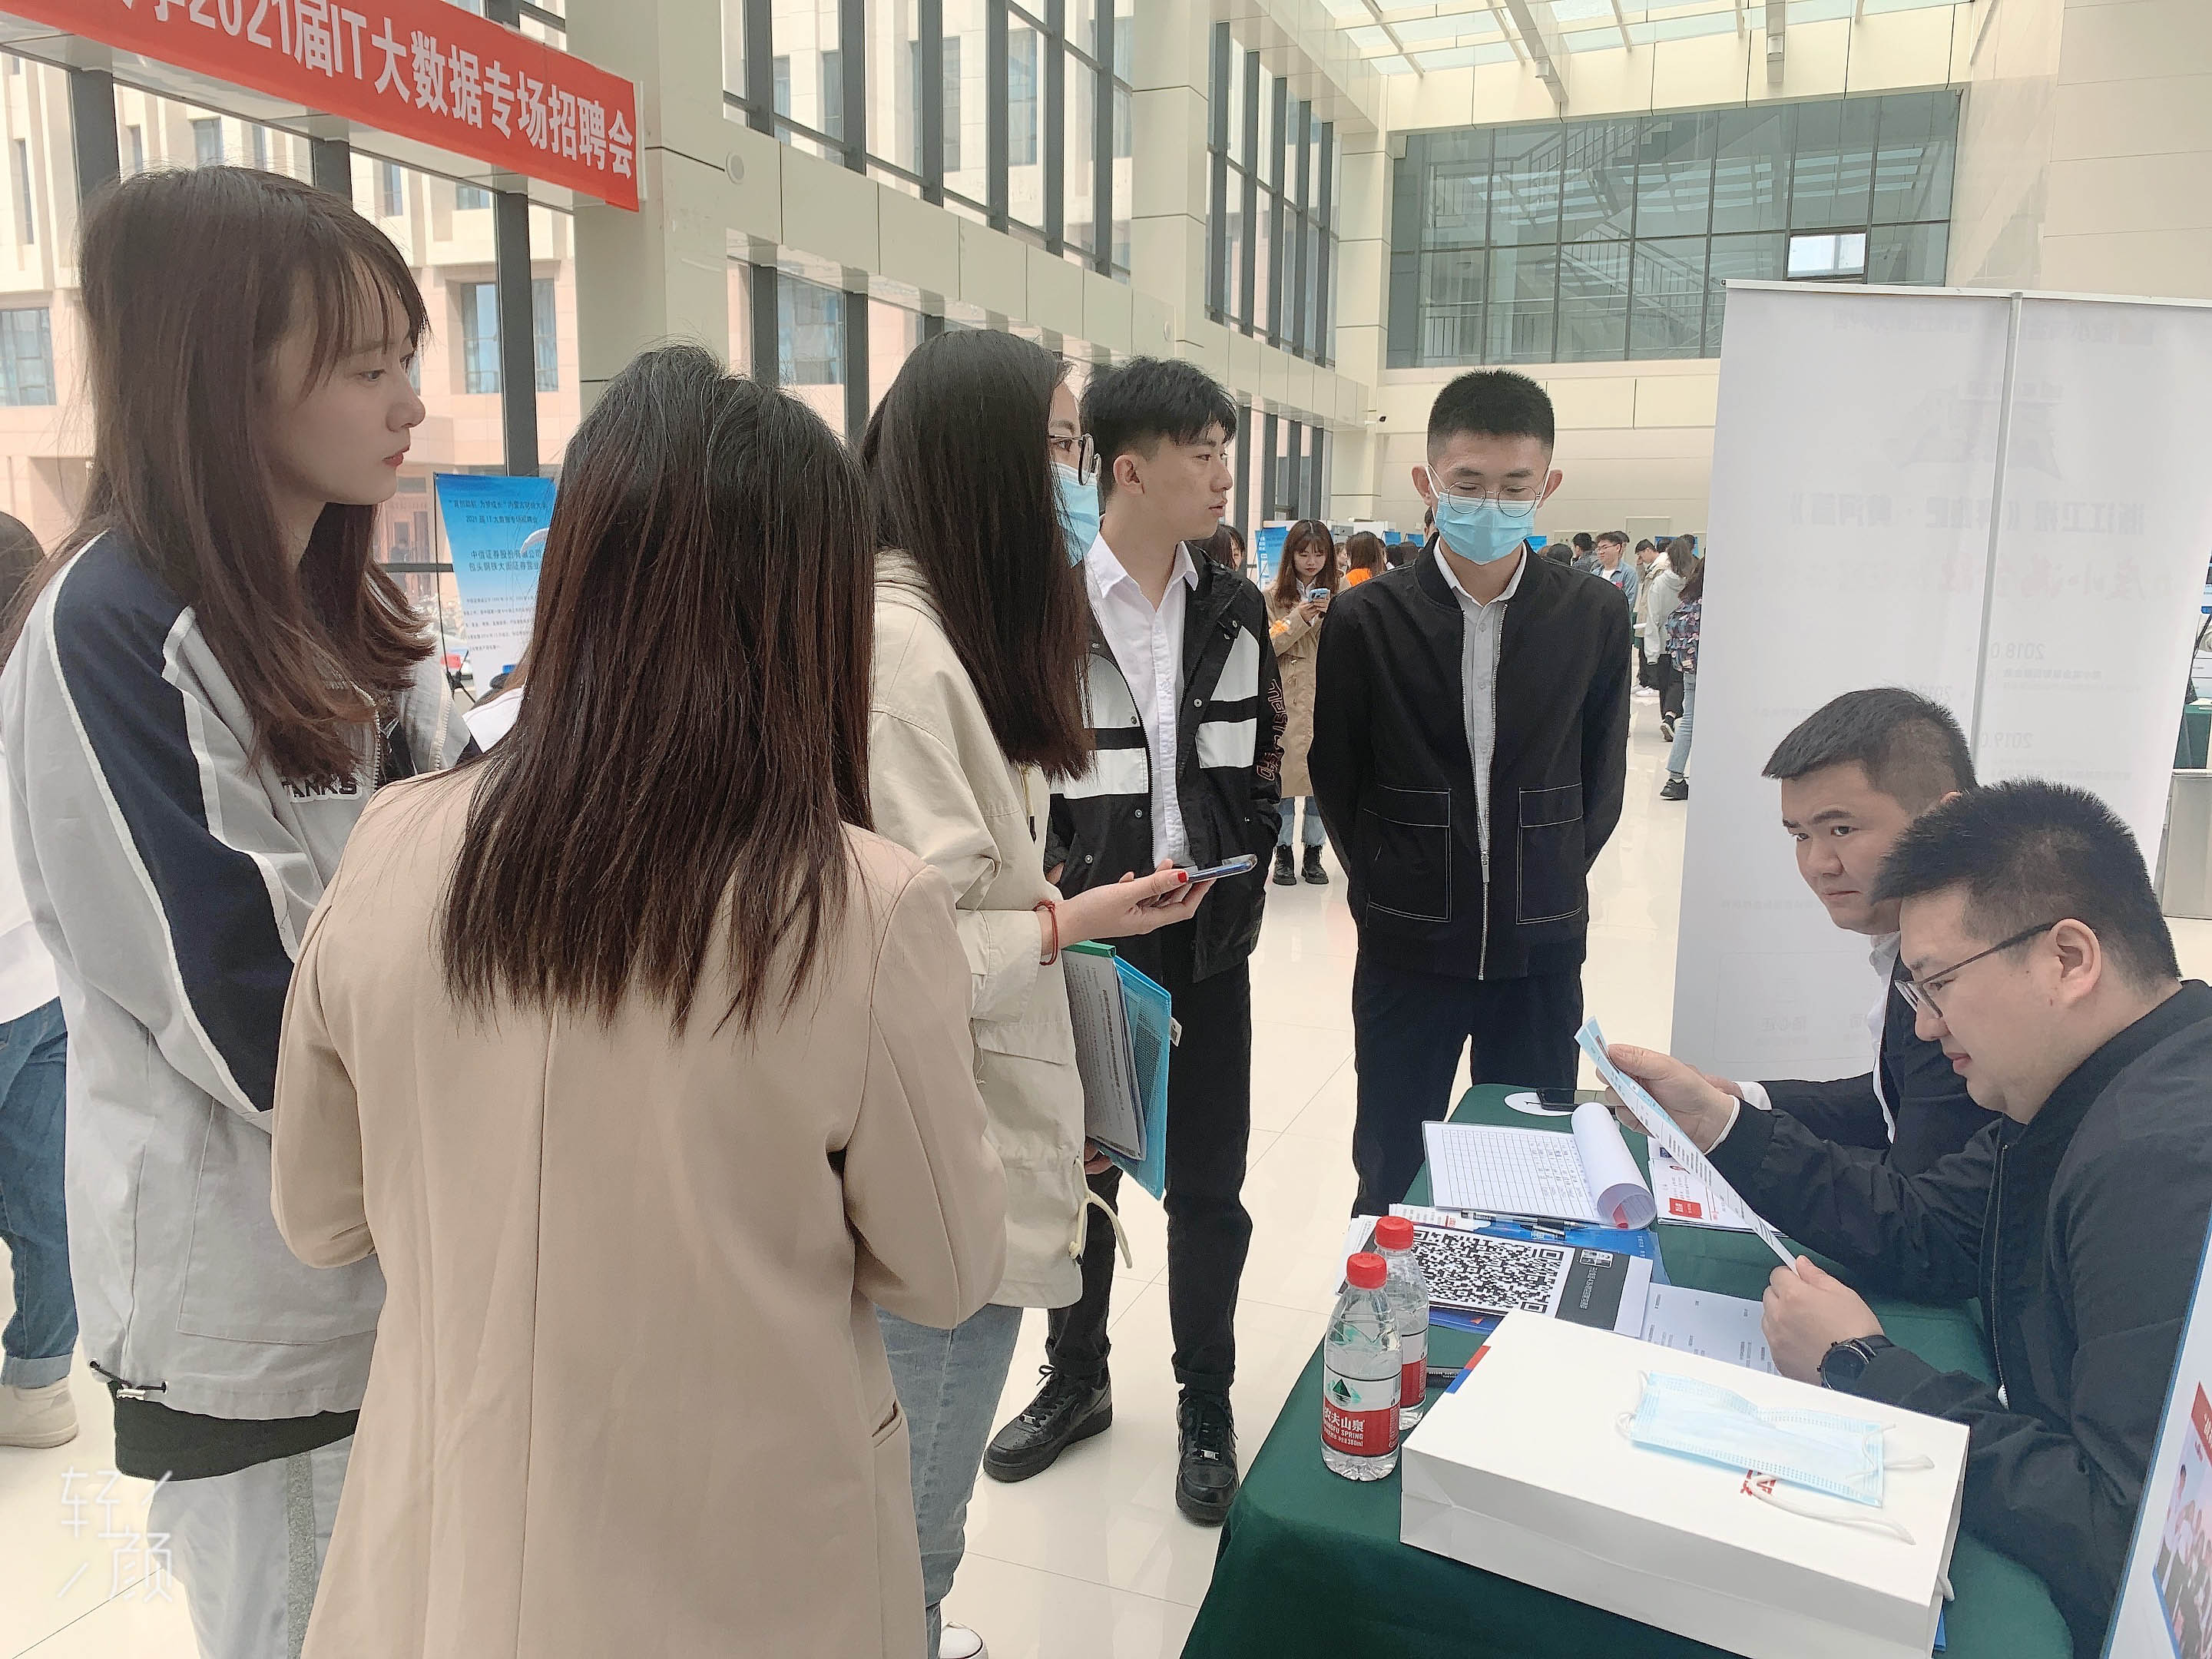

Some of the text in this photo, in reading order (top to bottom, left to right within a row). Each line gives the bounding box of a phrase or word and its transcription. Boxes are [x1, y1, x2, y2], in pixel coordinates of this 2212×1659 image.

[1324, 1406, 1365, 1432] 农夫山泉
[1340, 1429, 1364, 1440] SPRING
